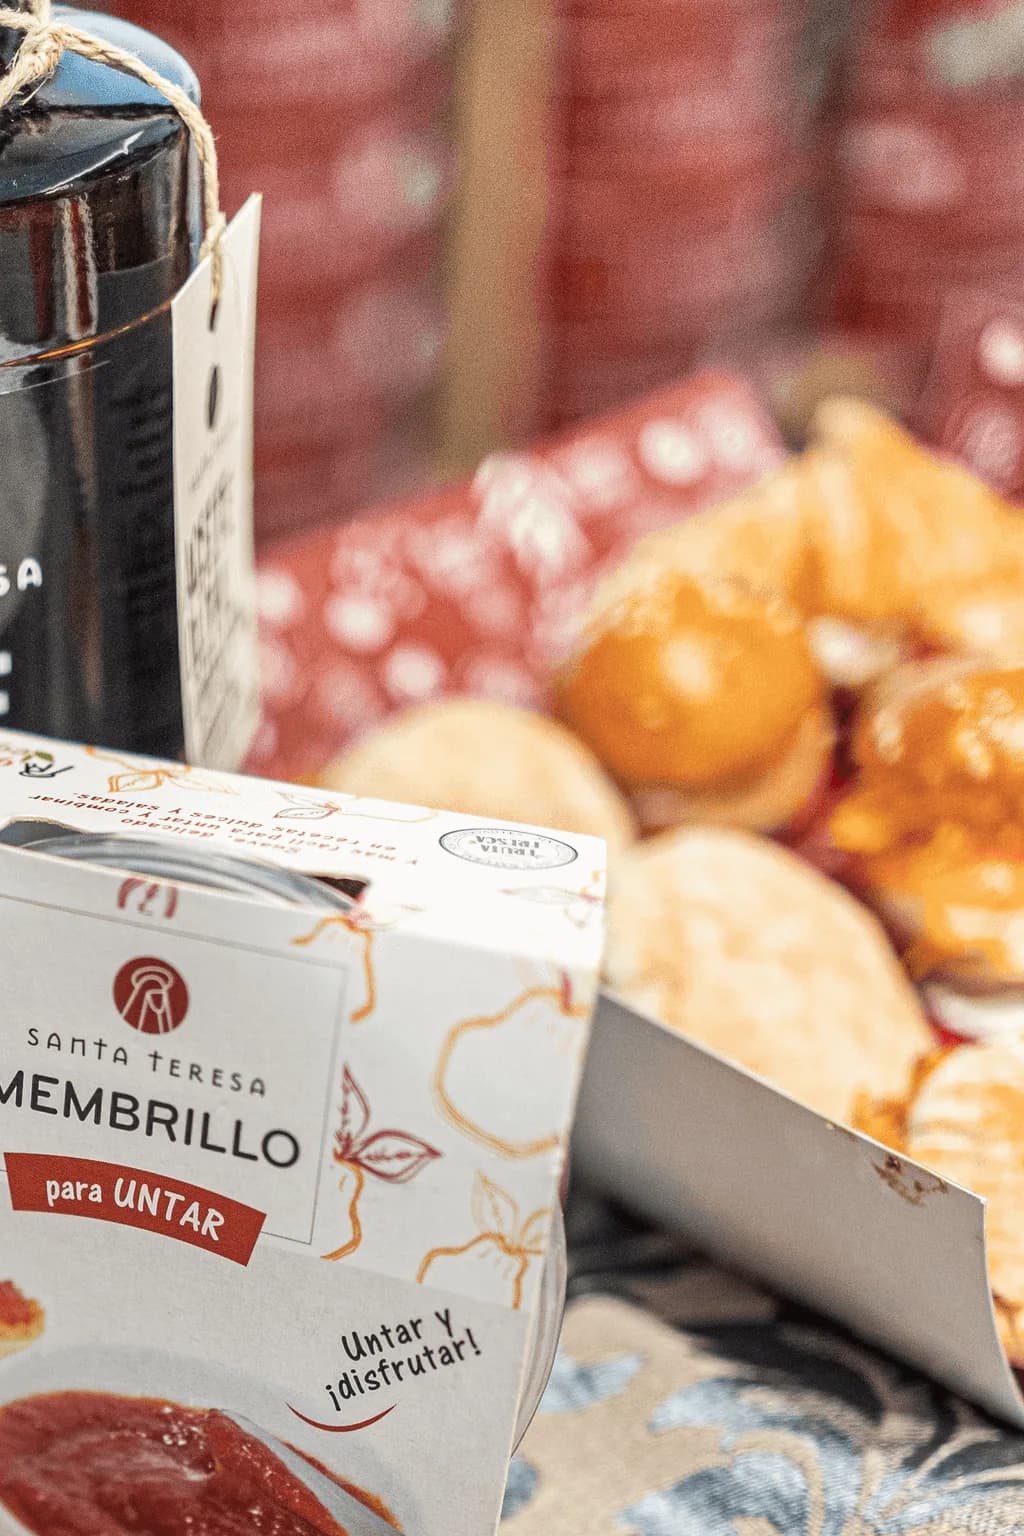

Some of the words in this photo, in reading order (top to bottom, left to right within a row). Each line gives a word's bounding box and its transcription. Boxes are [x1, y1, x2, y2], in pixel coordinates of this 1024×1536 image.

[29, 794, 129, 815] combinar
[27, 1027, 129, 1066] SANTA
[147, 1050, 266, 1098] TERESA
[46, 1179, 103, 1207] para
[114, 1177, 225, 1241] UNTAR
[325, 1328, 482, 1411] ¡disfrutar!
[341, 1318, 423, 1362] Untar
